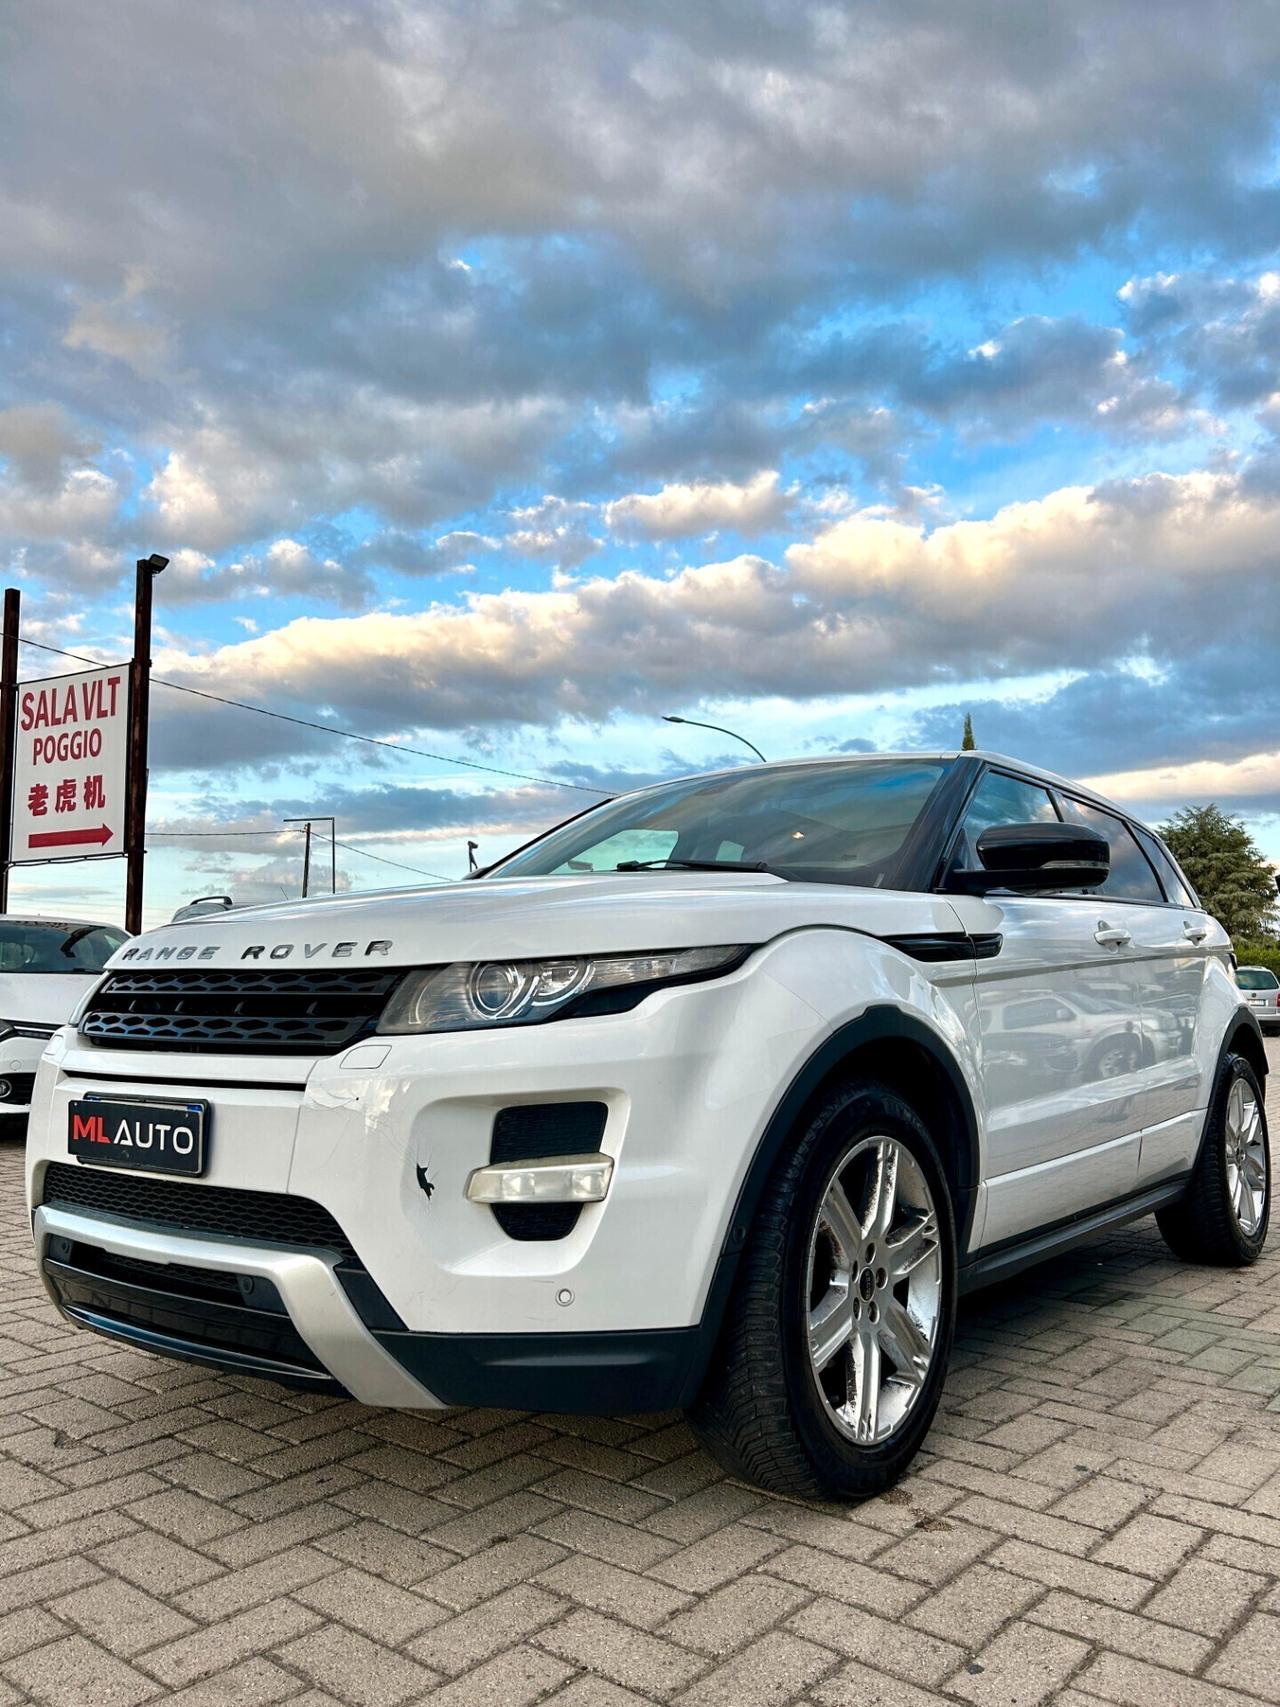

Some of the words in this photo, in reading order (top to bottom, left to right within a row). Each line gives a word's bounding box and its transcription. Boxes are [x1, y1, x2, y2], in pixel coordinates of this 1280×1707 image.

[20, 684, 78, 731] SALA
[82, 676, 121, 721] VLT
[33, 728, 102, 766] POGGIO
[27, 775, 106, 817] 老虎机
[121, 946, 221, 961] RANGE
[240, 940, 394, 960] ROVER
[72, 1114, 111, 1144] ML
[113, 1119, 194, 1155] AUTO
